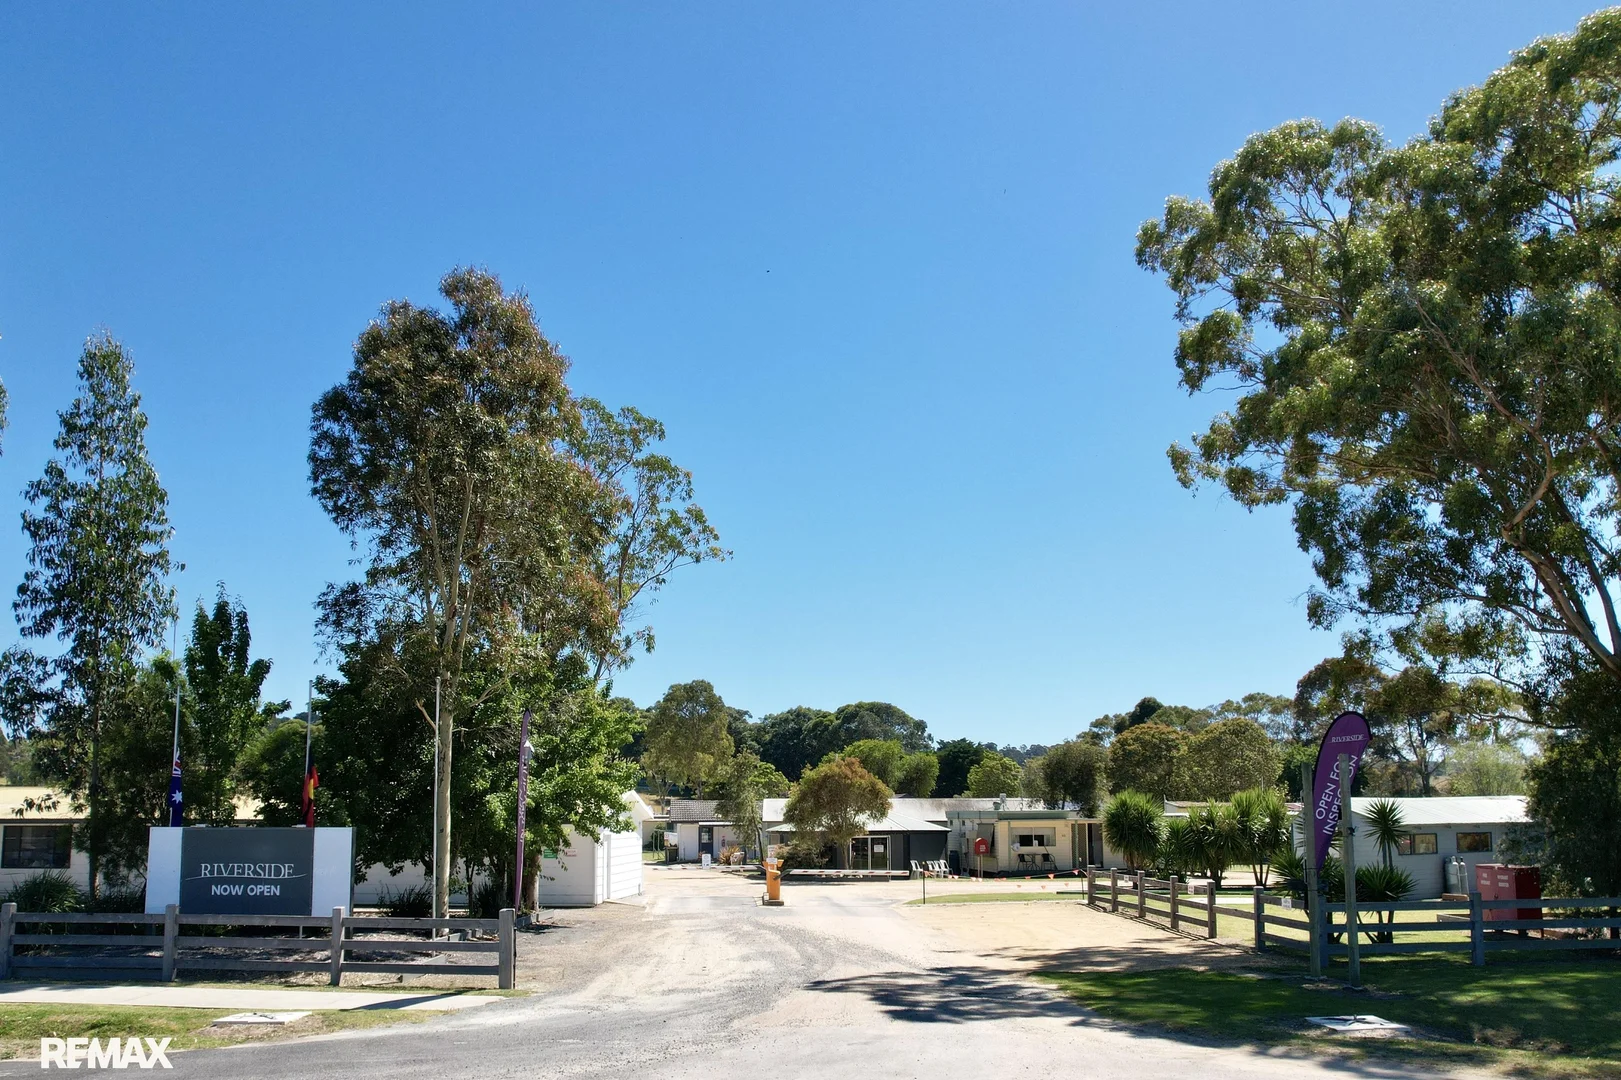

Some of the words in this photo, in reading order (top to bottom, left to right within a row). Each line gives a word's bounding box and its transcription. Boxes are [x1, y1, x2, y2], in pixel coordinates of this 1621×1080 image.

[1332, 734, 1364, 743] RIVERSIDE
[1315, 783, 1336, 819] OPEN
[1322, 755, 1358, 835] INSPEN
[200, 863, 294, 878] RIVERSIDE
[211, 884, 243, 896] NOW
[247, 884, 280, 896] OPEN
